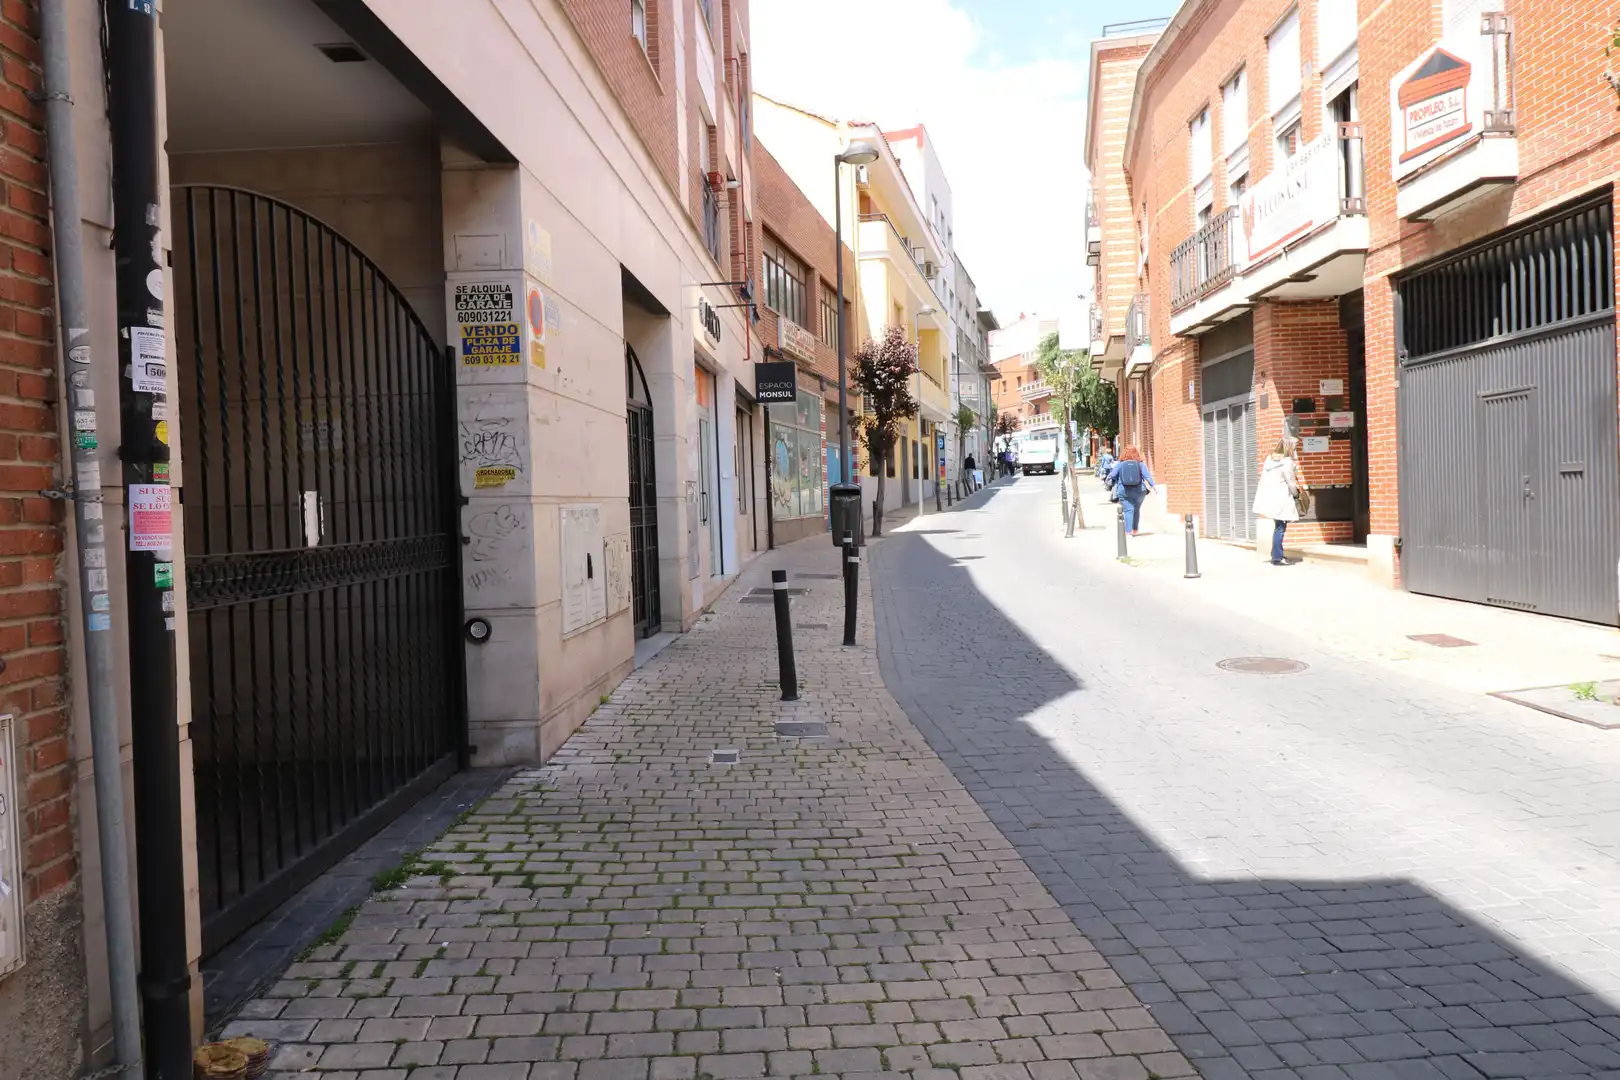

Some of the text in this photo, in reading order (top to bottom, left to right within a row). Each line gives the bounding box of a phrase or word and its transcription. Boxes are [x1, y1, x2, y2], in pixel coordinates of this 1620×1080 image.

[456, 284, 512, 294] SE ALQUILA
[494, 293, 506, 301] DE
[457, 300, 512, 310] GARAJE
[457, 310, 512, 323] 609031221
[463, 324, 518, 337] VENDO
[467, 337, 516, 346] PLAZA DE
[471, 345, 512, 354] GARAJE
[465, 354, 520, 365] 609 03 12 21
[759, 381, 793, 389] ESPACIO
[759, 390, 793, 399] MONSUL
